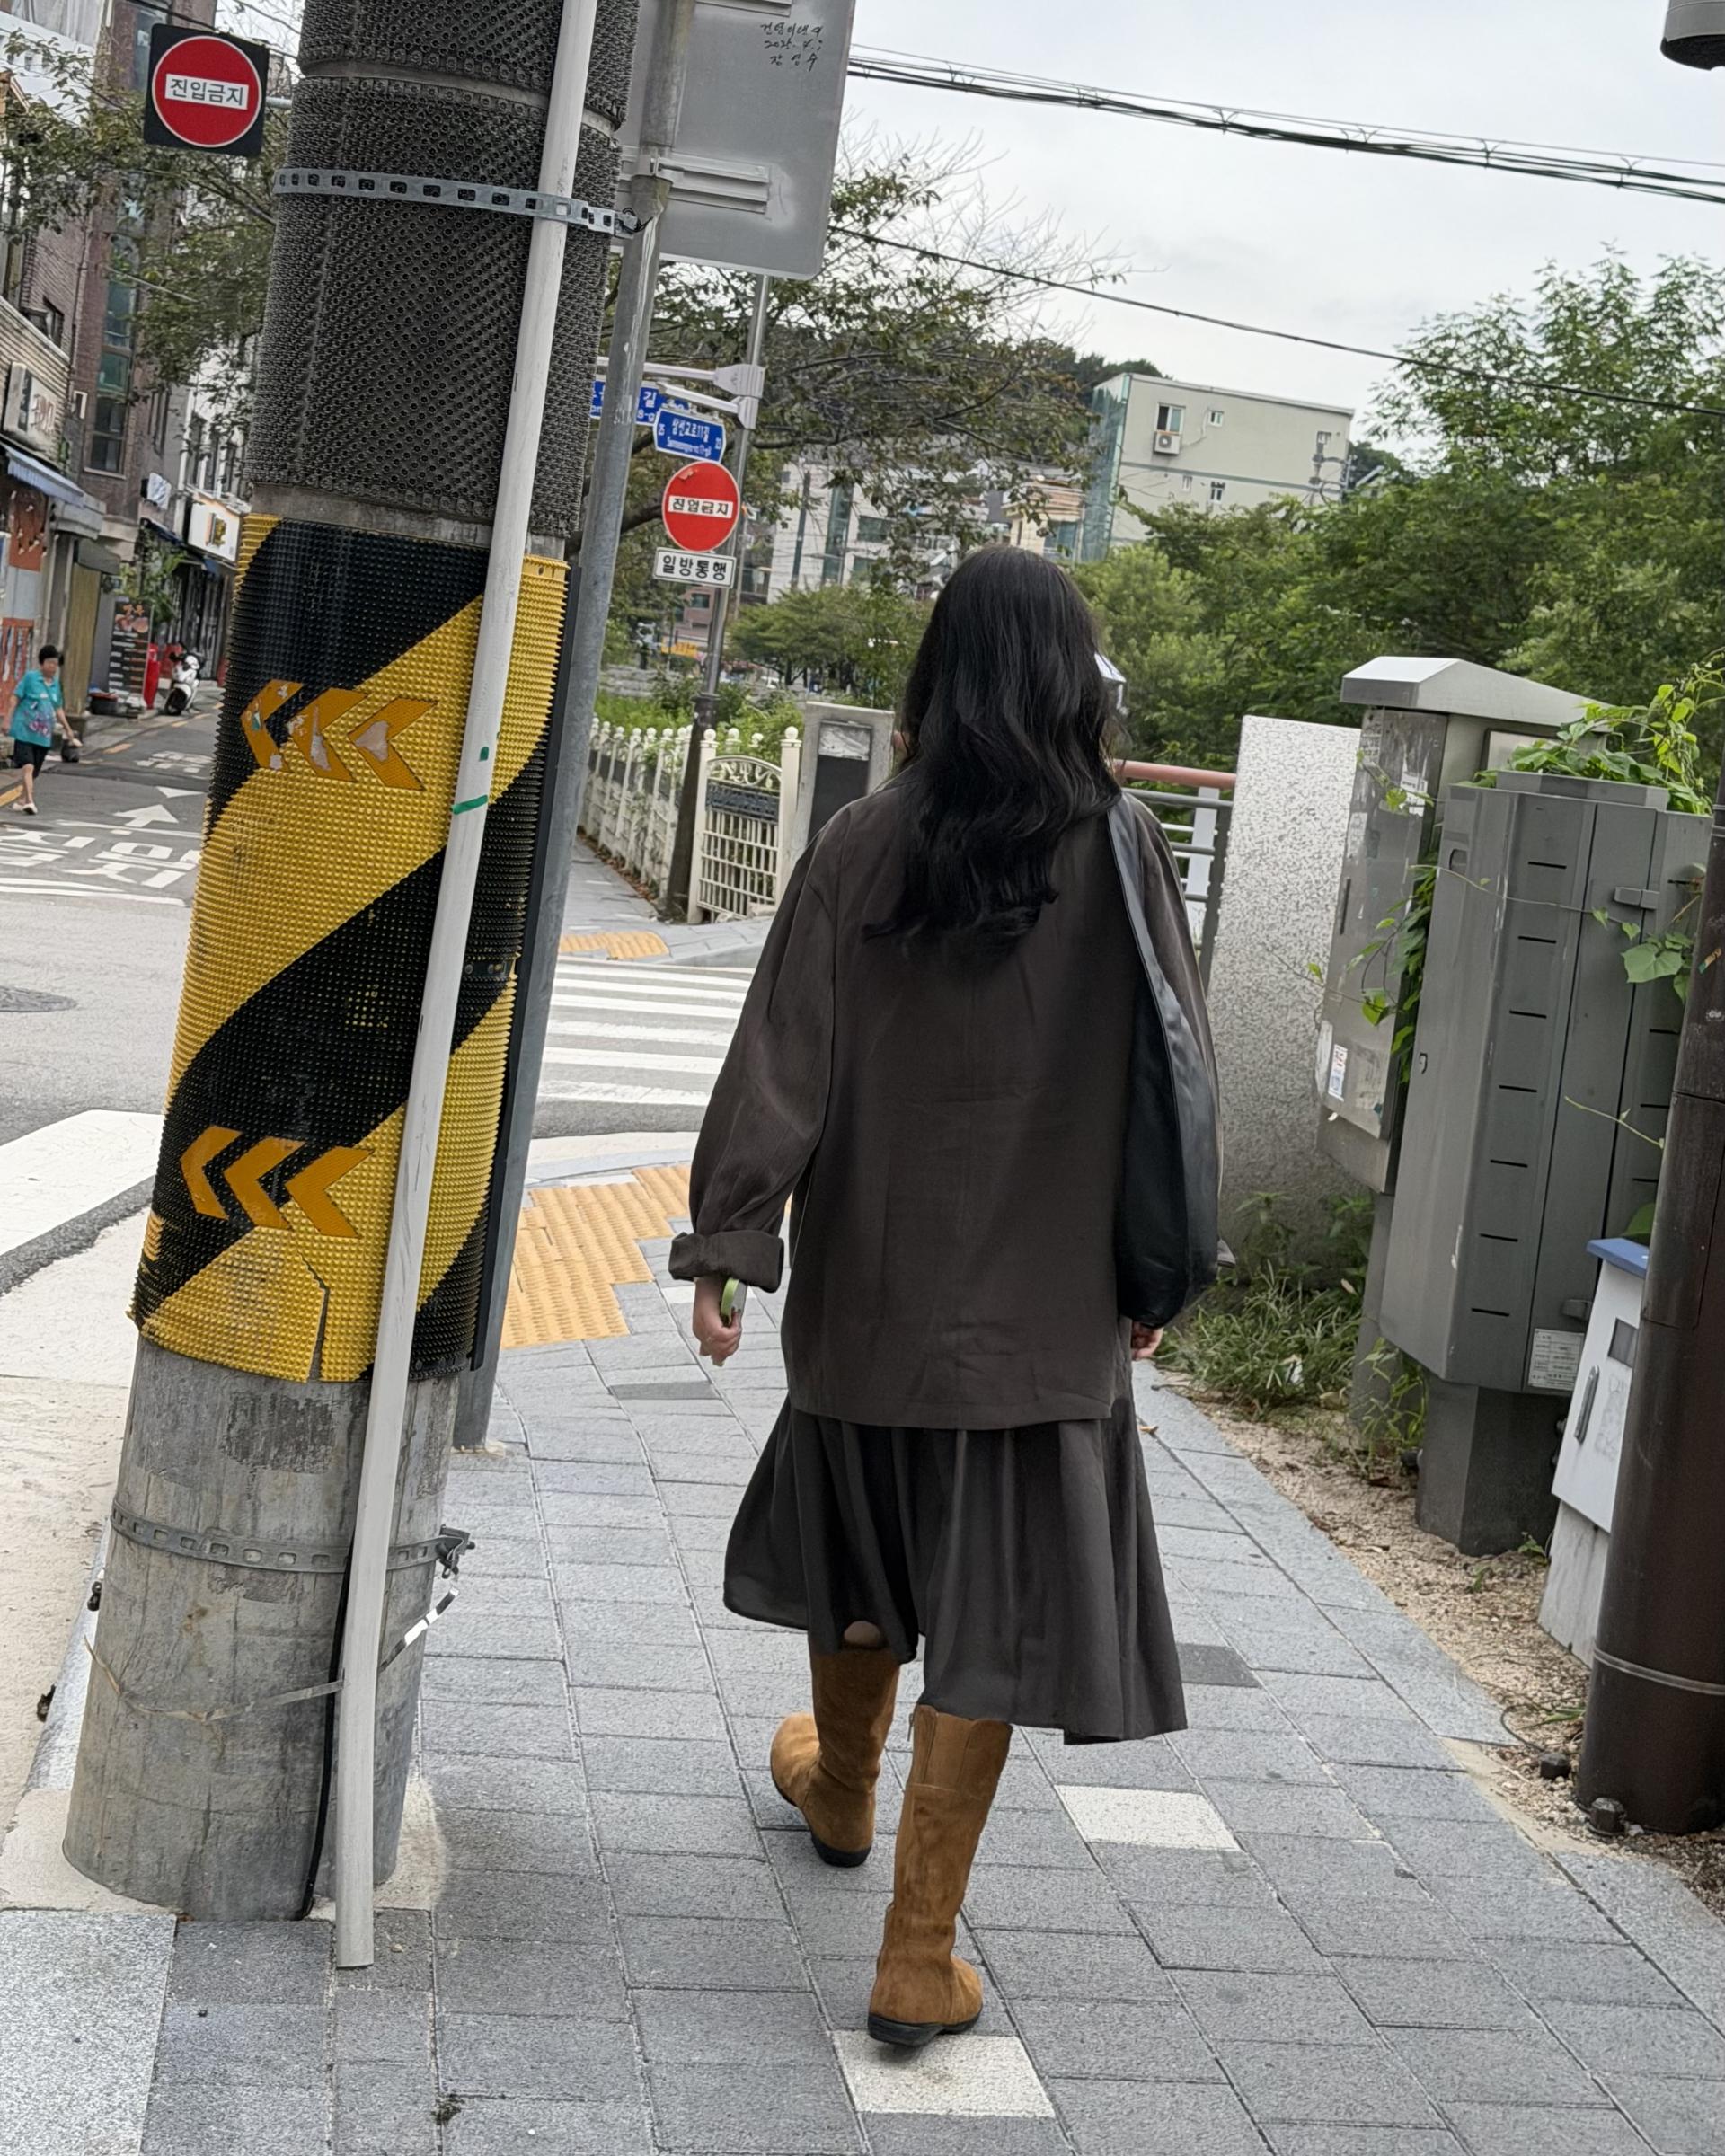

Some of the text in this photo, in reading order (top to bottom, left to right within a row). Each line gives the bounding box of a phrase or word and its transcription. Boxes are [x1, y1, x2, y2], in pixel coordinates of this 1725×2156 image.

[170, 78, 244, 106] 진입금지
[672, 498, 729, 517] 진입금지
[662, 554, 728, 581] 일방통행
